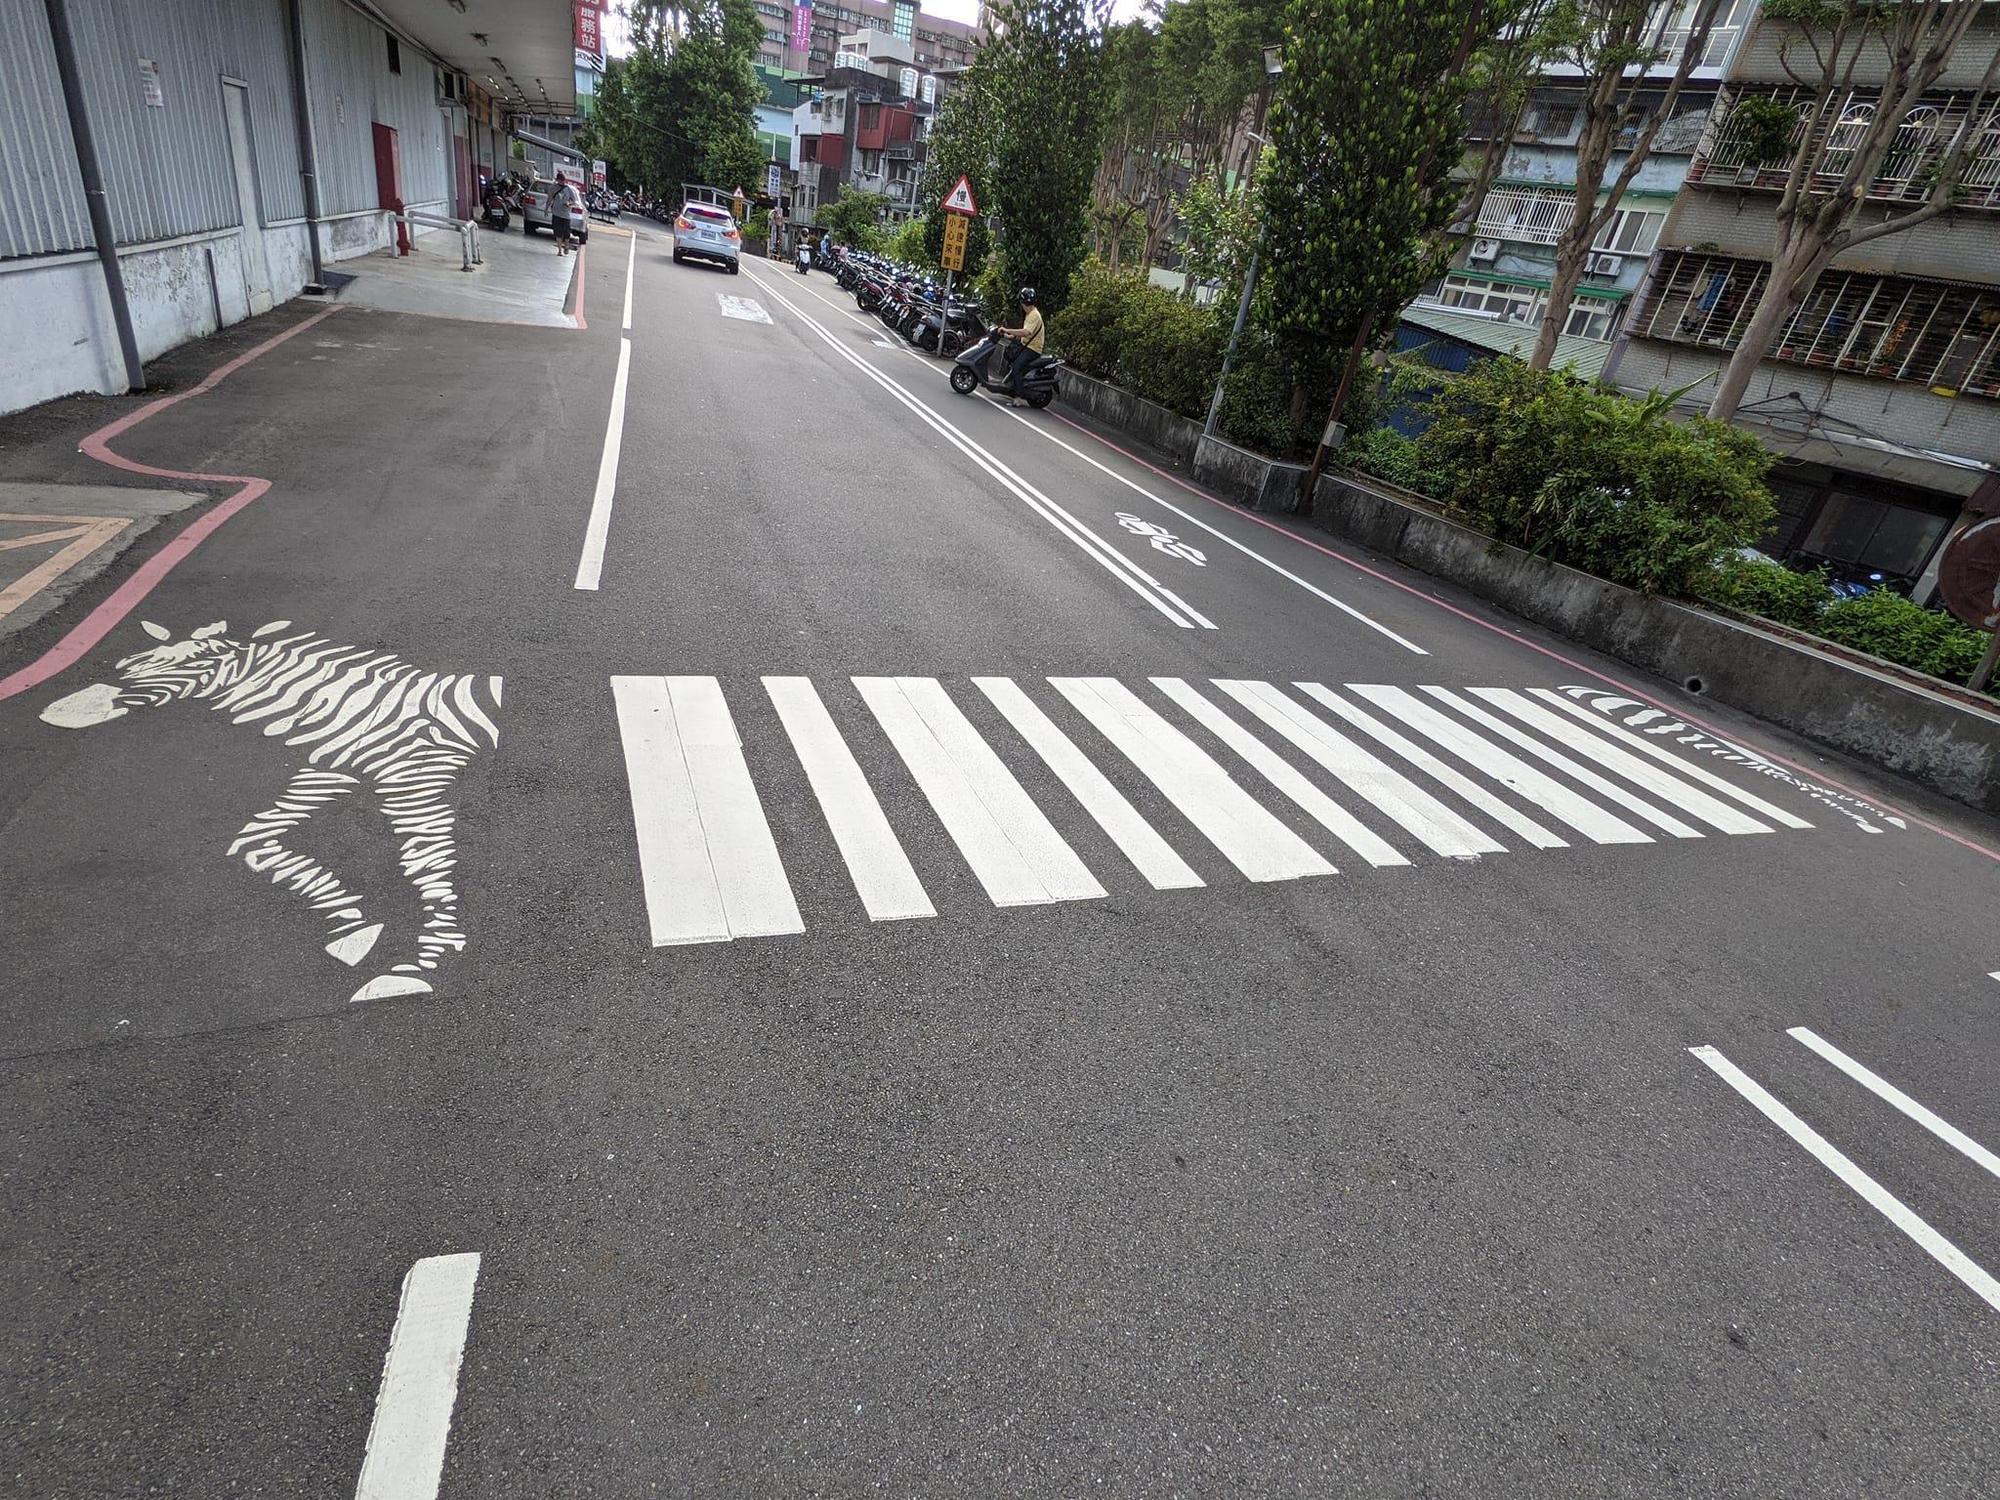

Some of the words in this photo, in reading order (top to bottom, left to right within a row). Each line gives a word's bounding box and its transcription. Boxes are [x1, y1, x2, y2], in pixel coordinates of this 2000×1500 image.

[580, 0, 600, 49] 服務站
[956, 190, 967, 202] 慢
[952, 219, 966, 269] 減速慢行
